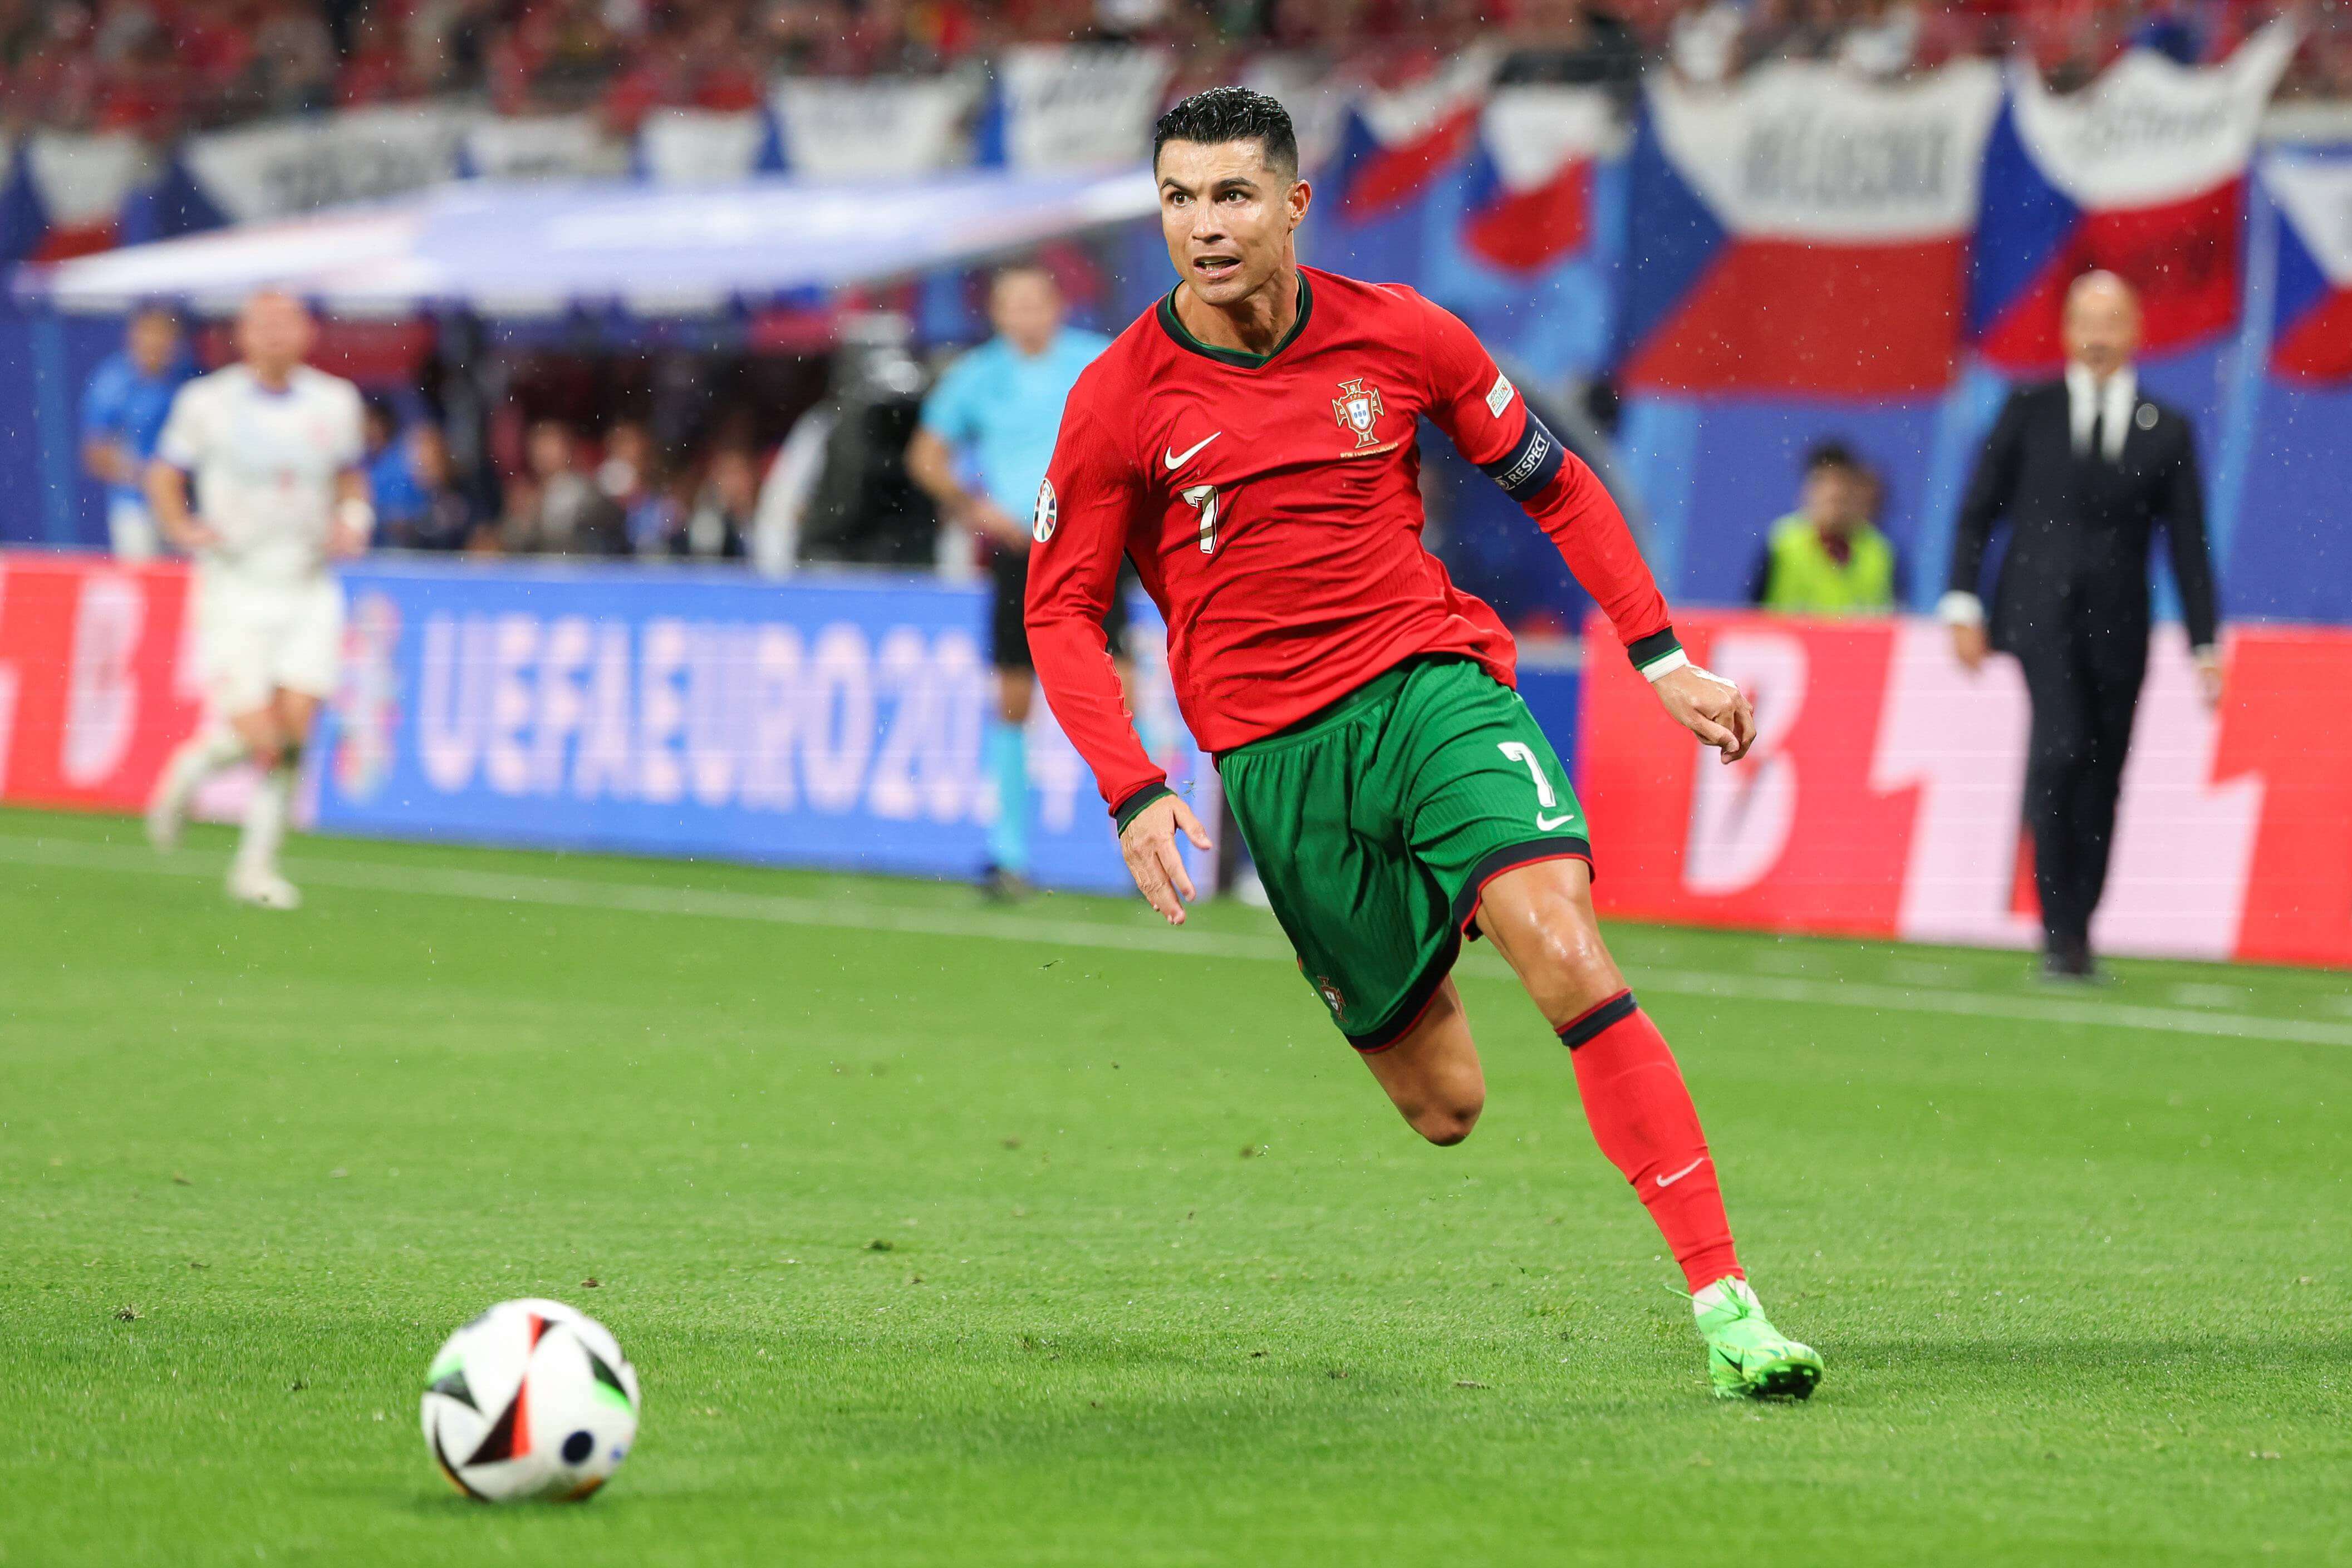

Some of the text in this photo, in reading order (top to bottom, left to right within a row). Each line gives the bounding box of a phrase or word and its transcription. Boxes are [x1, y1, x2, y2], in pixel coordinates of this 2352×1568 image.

[1508, 433, 1547, 483] RESPECT
[1180, 484, 1219, 554] 7
[1496, 741, 1557, 808] 7
